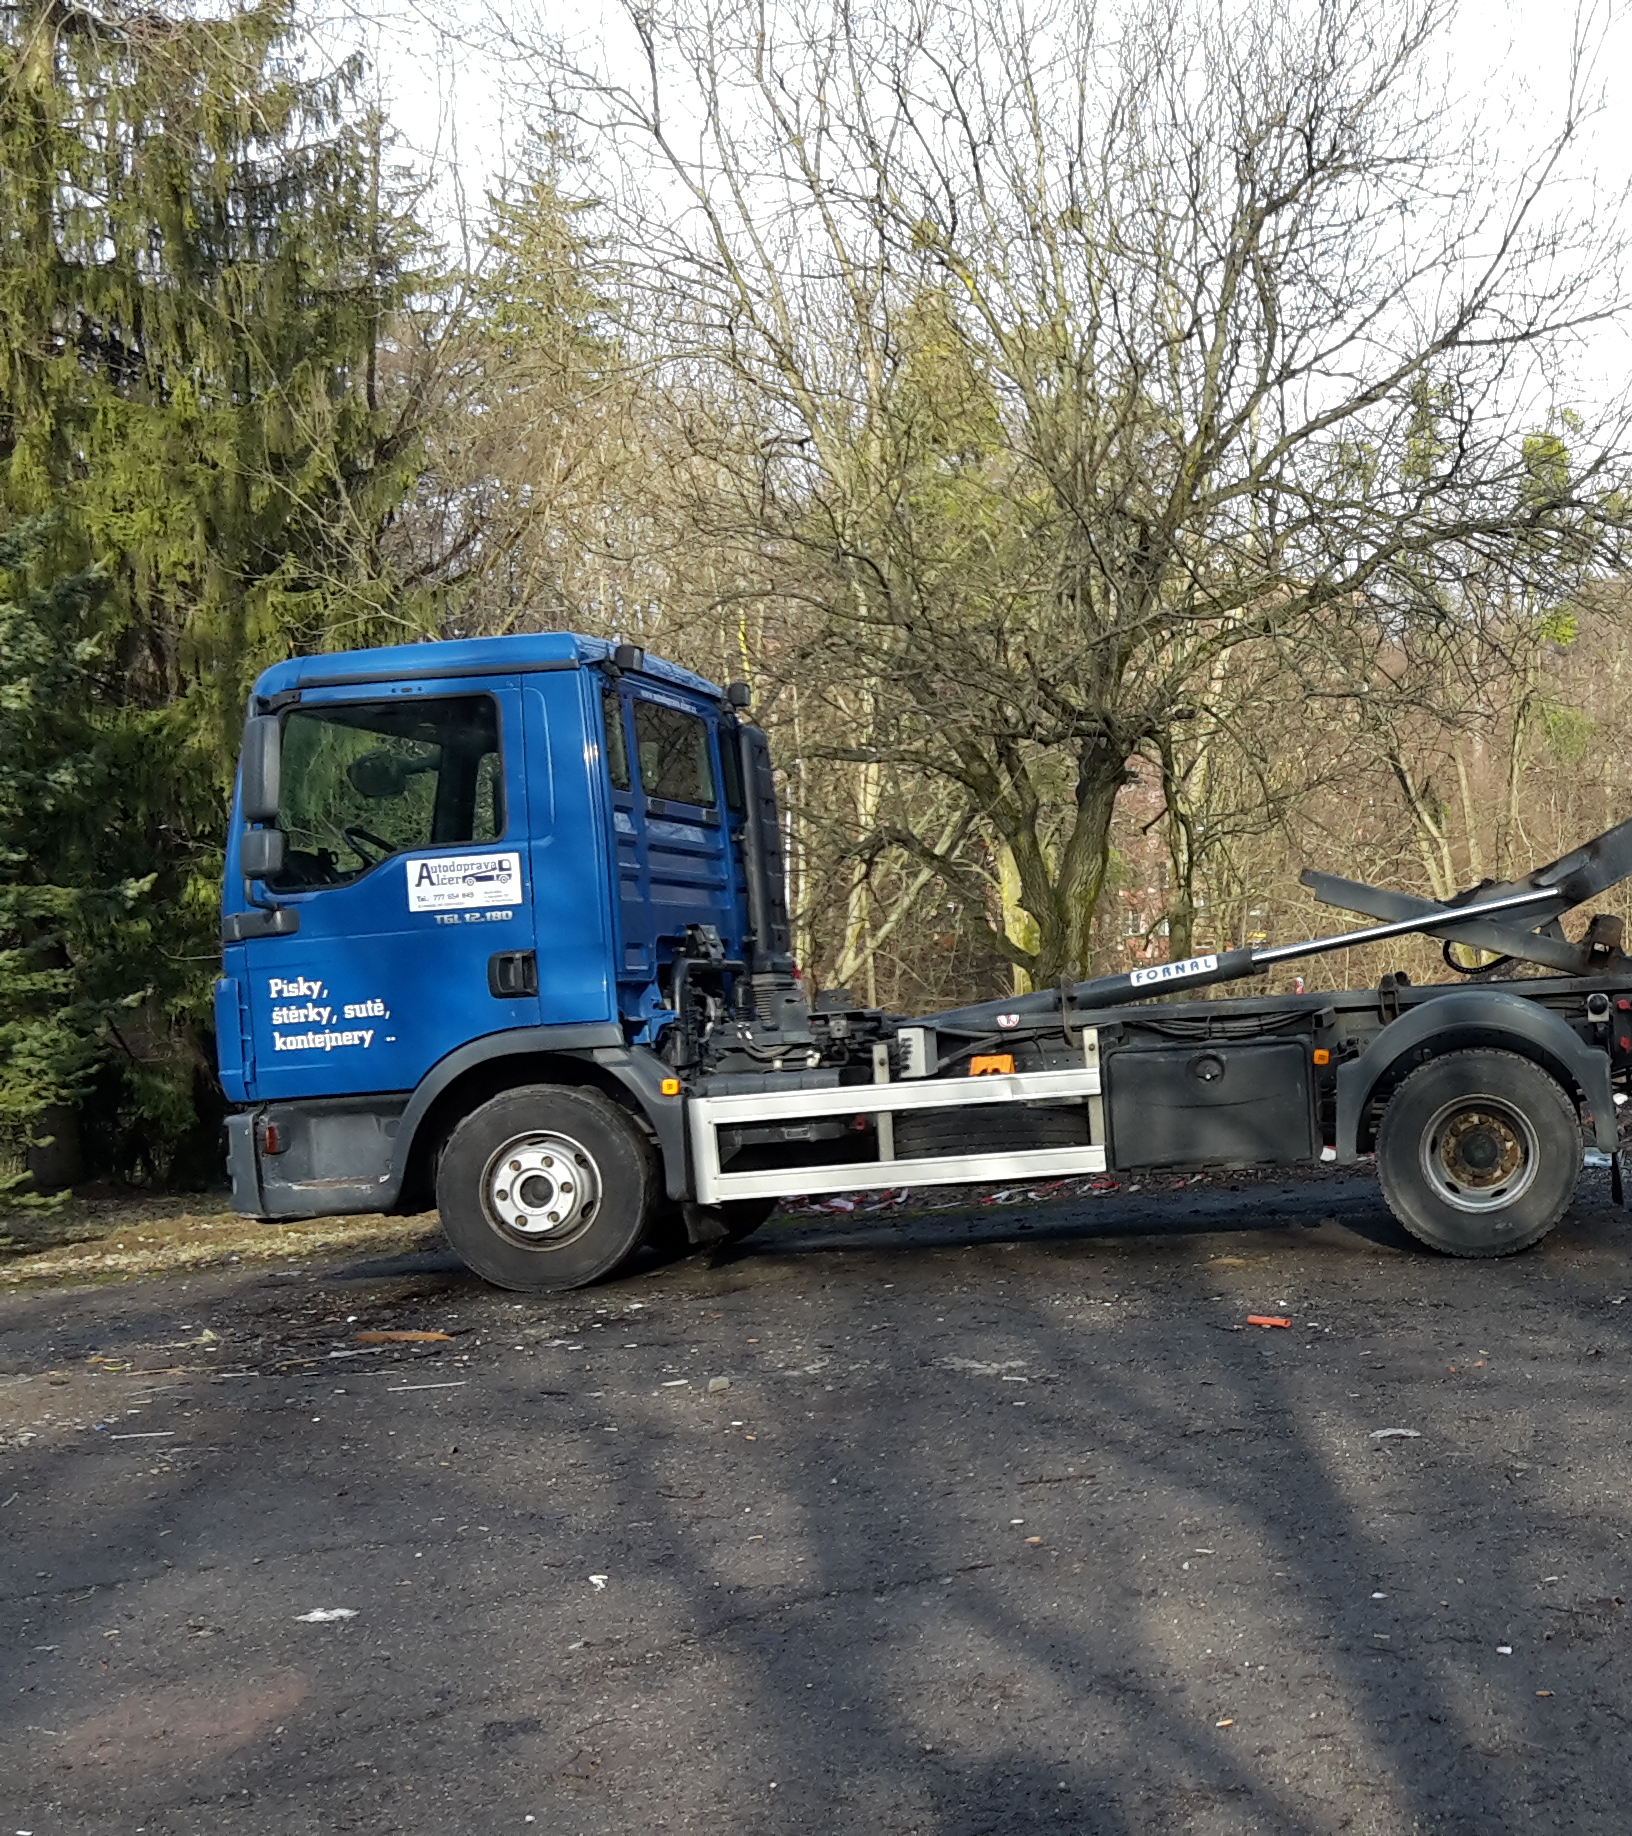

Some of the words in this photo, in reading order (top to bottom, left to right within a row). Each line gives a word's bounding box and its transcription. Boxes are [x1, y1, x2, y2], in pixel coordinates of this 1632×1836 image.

[415, 860, 497, 887] Autodoprava
[434, 914, 462, 924] TGL
[1135, 958, 1212, 983] FORNAL
[273, 1029, 374, 1051] kontejnery
